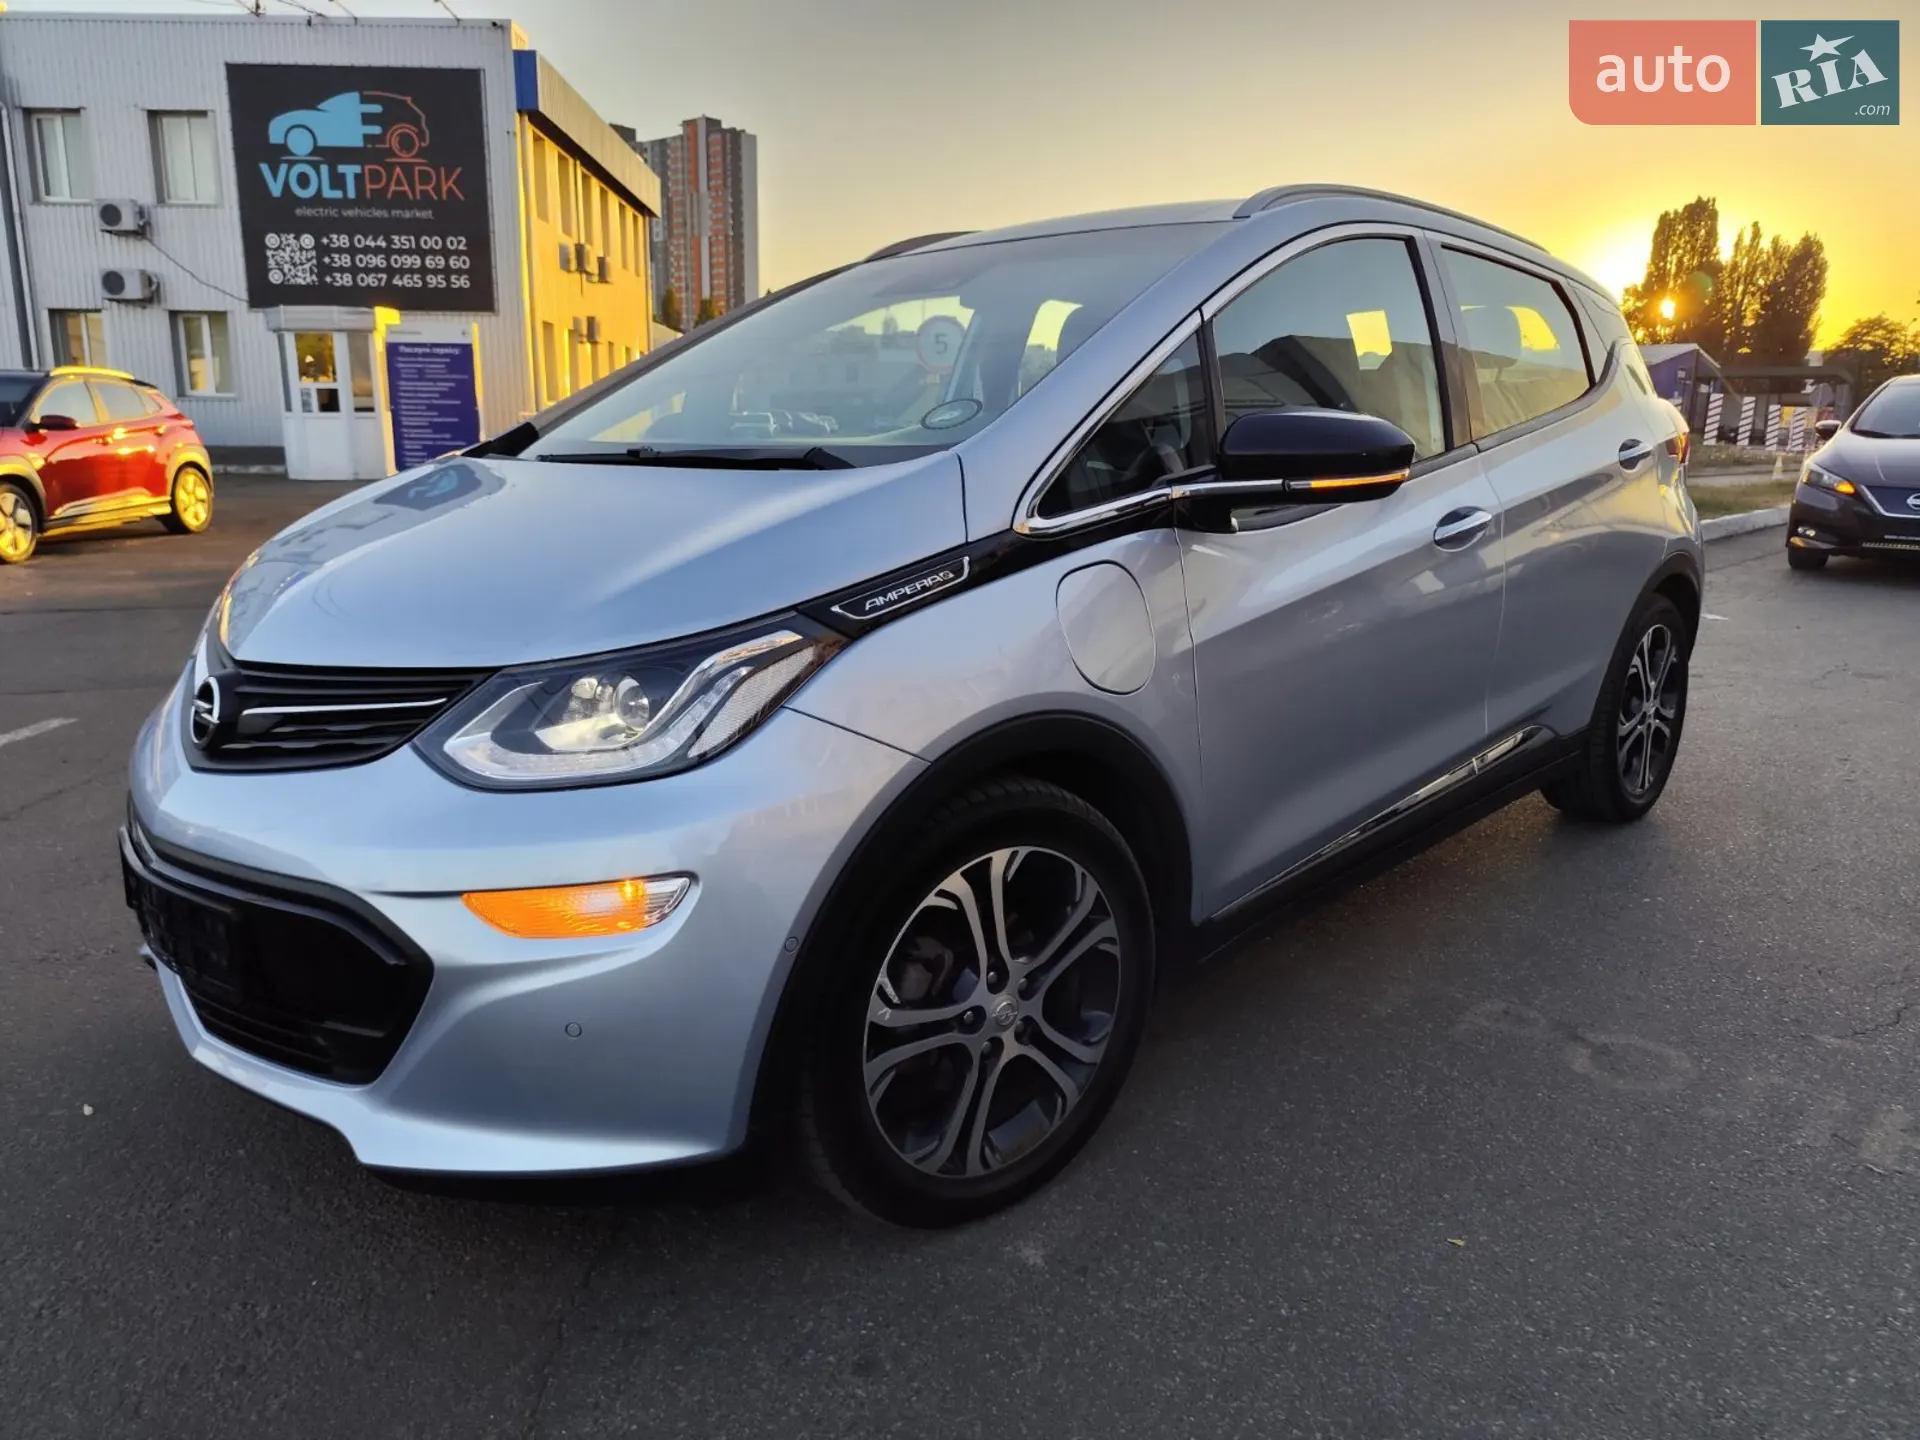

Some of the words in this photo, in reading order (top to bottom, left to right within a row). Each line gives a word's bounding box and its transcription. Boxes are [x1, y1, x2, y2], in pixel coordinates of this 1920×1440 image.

[295, 206, 339, 218] electric
[341, 207, 389, 219] vehicles
[391, 208, 434, 220] market
[321, 234, 350, 248] +38
[353, 234, 387, 249] 044
[390, 235, 416, 249] 351
[420, 236, 443, 250] 00
[446, 236, 468, 250] 02
[322, 253, 351, 267] +38
[355, 254, 388, 269] 096
[390, 254, 422, 269] 099
[425, 255, 446, 269] 69
[449, 255, 470, 270] 60
[324, 272, 354, 287] +38
[356, 273, 388, 287] 067
[392, 273, 423, 288] 465
[426, 275, 447, 288] 95
[450, 275, 471, 289] 56
[934, 333, 948, 355] 5
